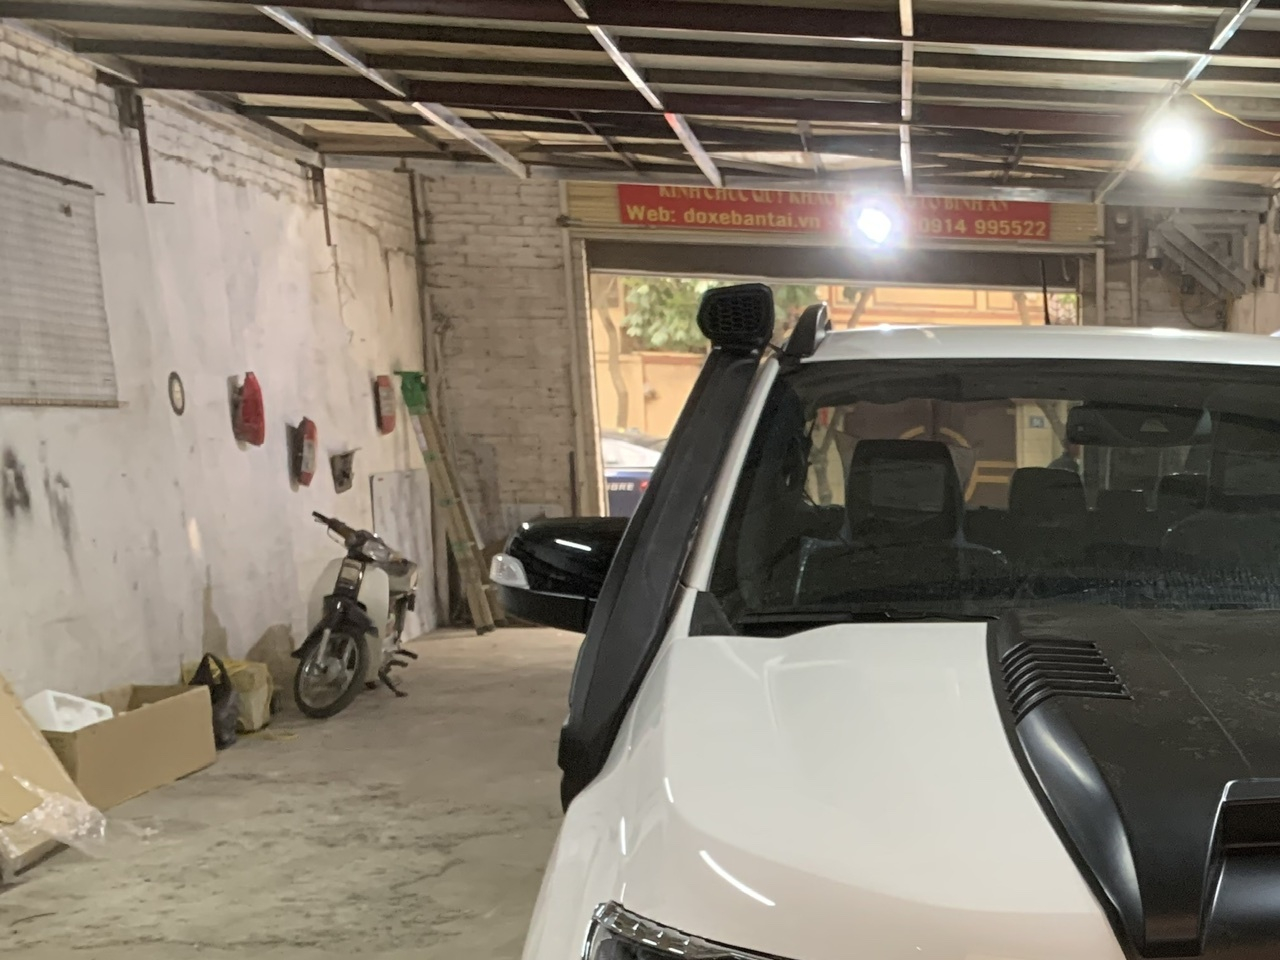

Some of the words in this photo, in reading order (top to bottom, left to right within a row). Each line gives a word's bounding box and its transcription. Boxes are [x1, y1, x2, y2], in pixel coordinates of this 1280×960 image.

[626, 204, 675, 223] Web:
[683, 207, 821, 229] doxebantai.vn
[919, 218, 968, 234] 0914
[974, 219, 1047, 237] 995522
